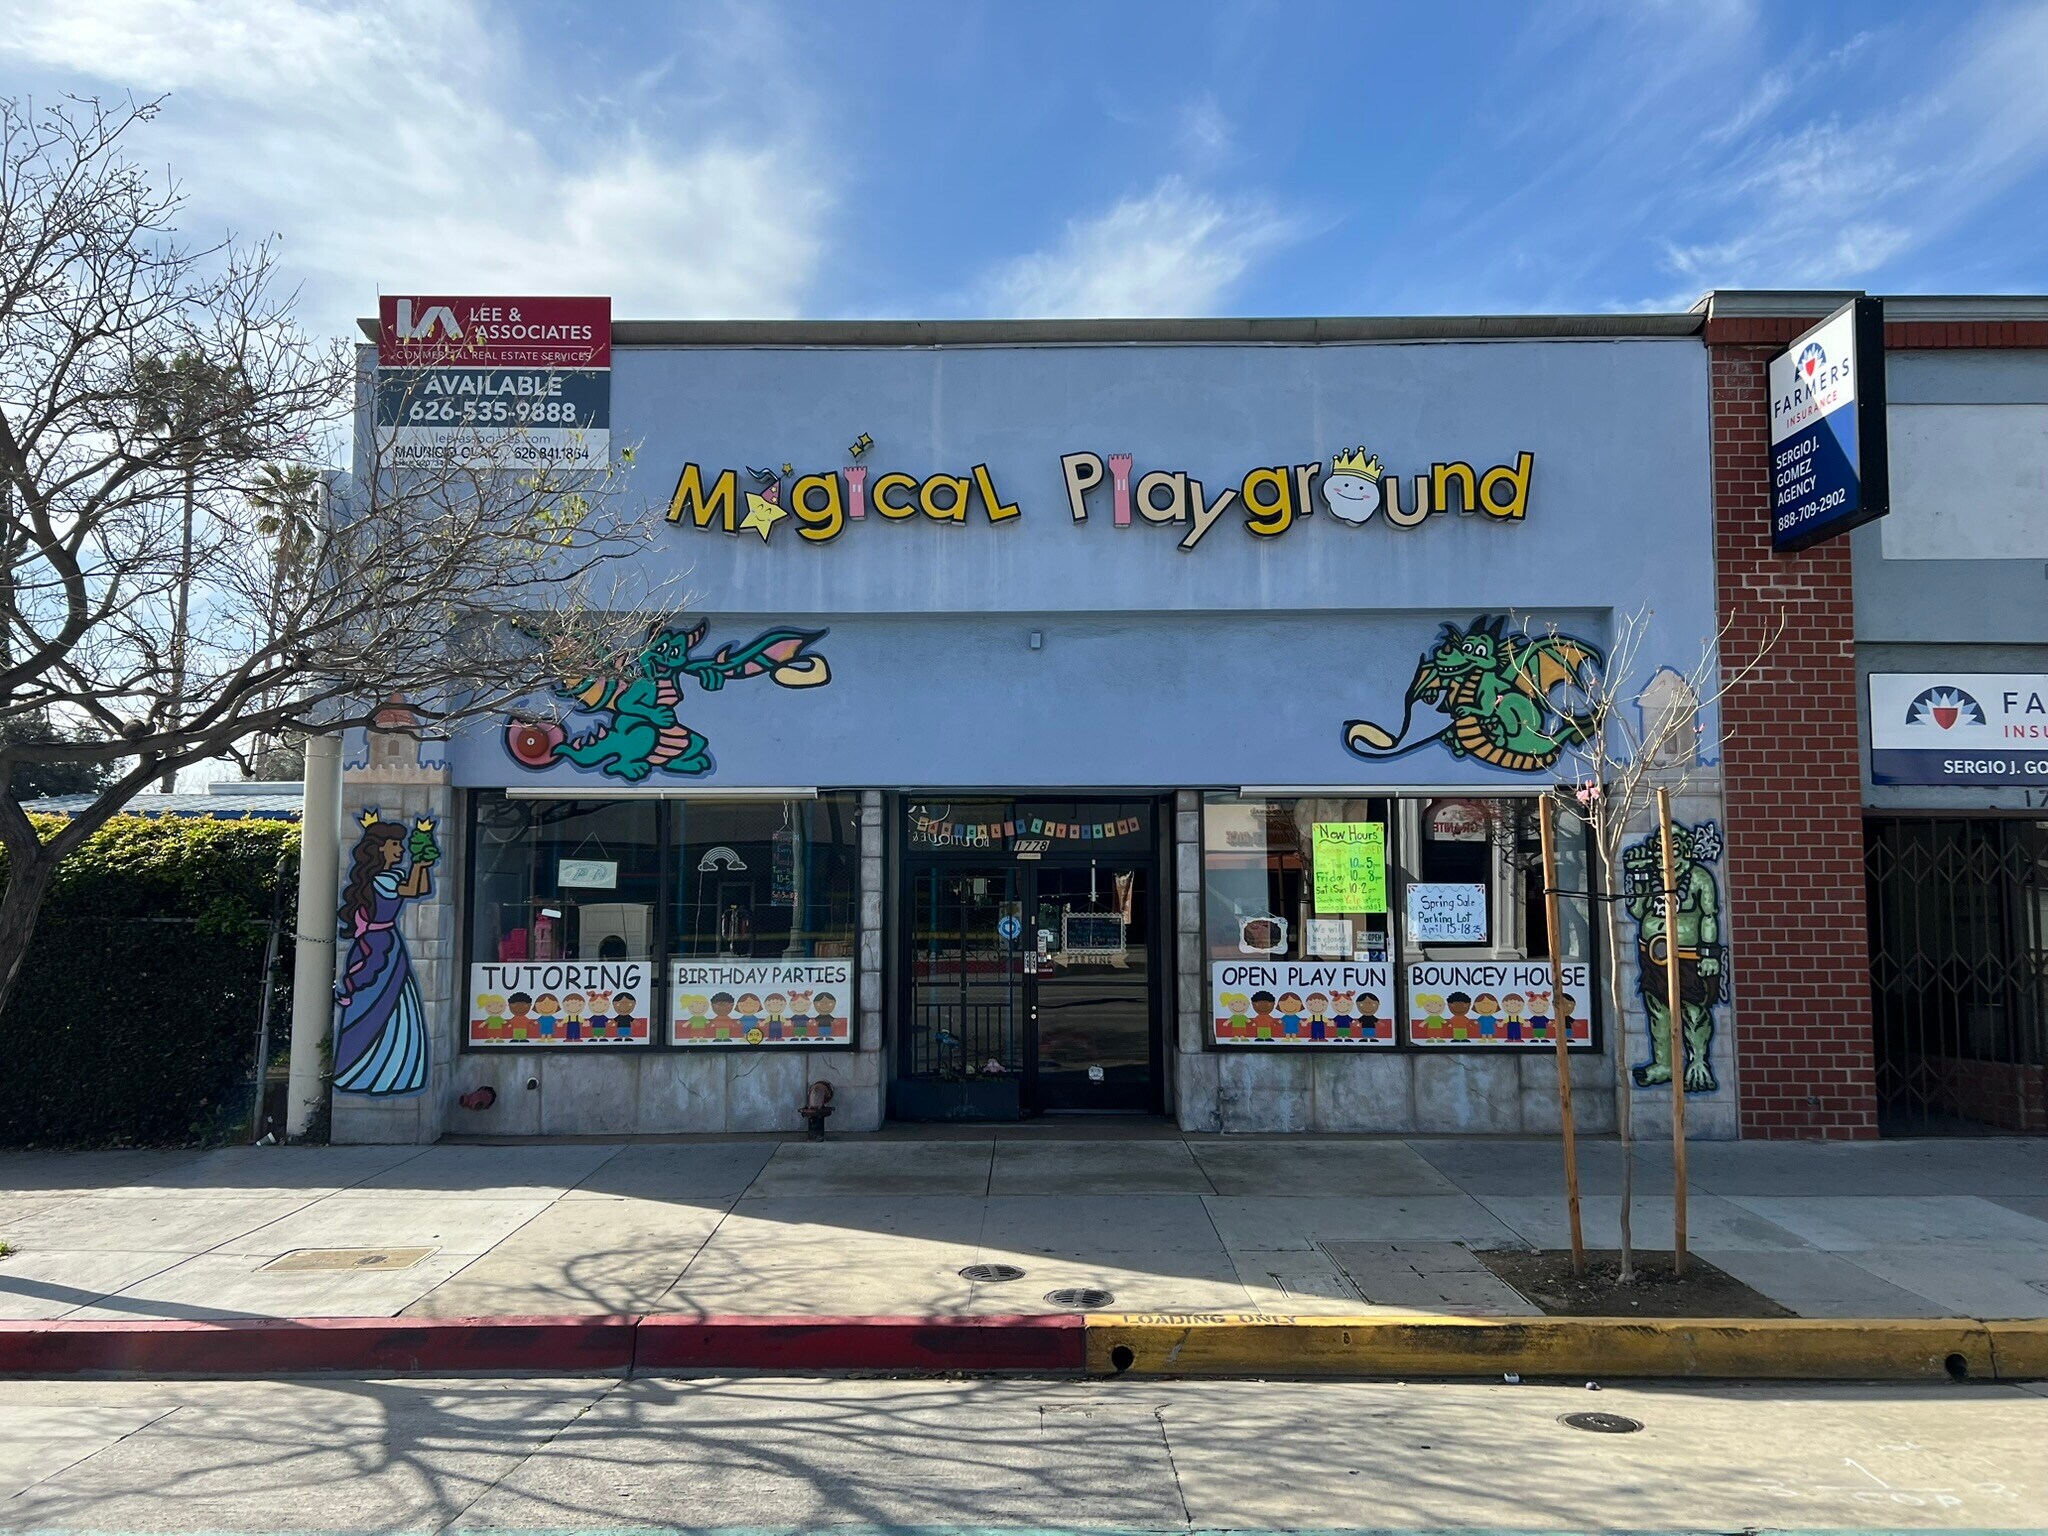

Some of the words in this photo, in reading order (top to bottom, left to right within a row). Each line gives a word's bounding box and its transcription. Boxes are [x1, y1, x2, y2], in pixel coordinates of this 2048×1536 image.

[470, 307, 502, 322] LEE
[508, 307, 522, 322] &
[475, 325, 592, 340] ASSOCIATES
[471, 351, 498, 361] REAL
[500, 352, 538, 362] ESTATE
[541, 352, 592, 362] SERVICES
[424, 375, 562, 396] AVAILABLE
[1774, 357, 1850, 419] FARMERS
[409, 401, 576, 423] 626-535-9888
[1786, 390, 1838, 429] INSURANCE
[1776, 440, 1812, 471] SERGIO
[1811, 435, 1820, 453] J.
[1776, 458, 1812, 488] GOMEZ
[1777, 475, 1817, 507] AGENCY
[1778, 488, 1846, 531] 888-709-2902
[1943, 760, 2006, 774] SERGIO
[2009, 760, 2021, 774] J.
[1319, 825, 1345, 839] New
[1348, 825, 1378, 840] Hours
[1016, 841, 1048, 851] 1778
[1420, 895, 1454, 911] Spring
[1457, 894, 1475, 907] Sale
[1418, 911, 1455, 926] Parking
[1456, 911, 1472, 923] Lot
[1421, 924, 1442, 935] April
[481, 964, 642, 990] TUTORING
[678, 967, 768, 985] BIRTHDAY
[772, 966, 847, 984] PARTIES
[1222, 967, 1277, 986] OPEN
[1288, 967, 1337, 987] PLAY
[1343, 968, 1387, 987] FUN
[1412, 966, 1507, 986] BOUNCEY
[1514, 966, 1586, 986] HOUSE
[1122, 1314, 1226, 1324] LOADING
[1238, 1314, 1298, 1324] ONLY
